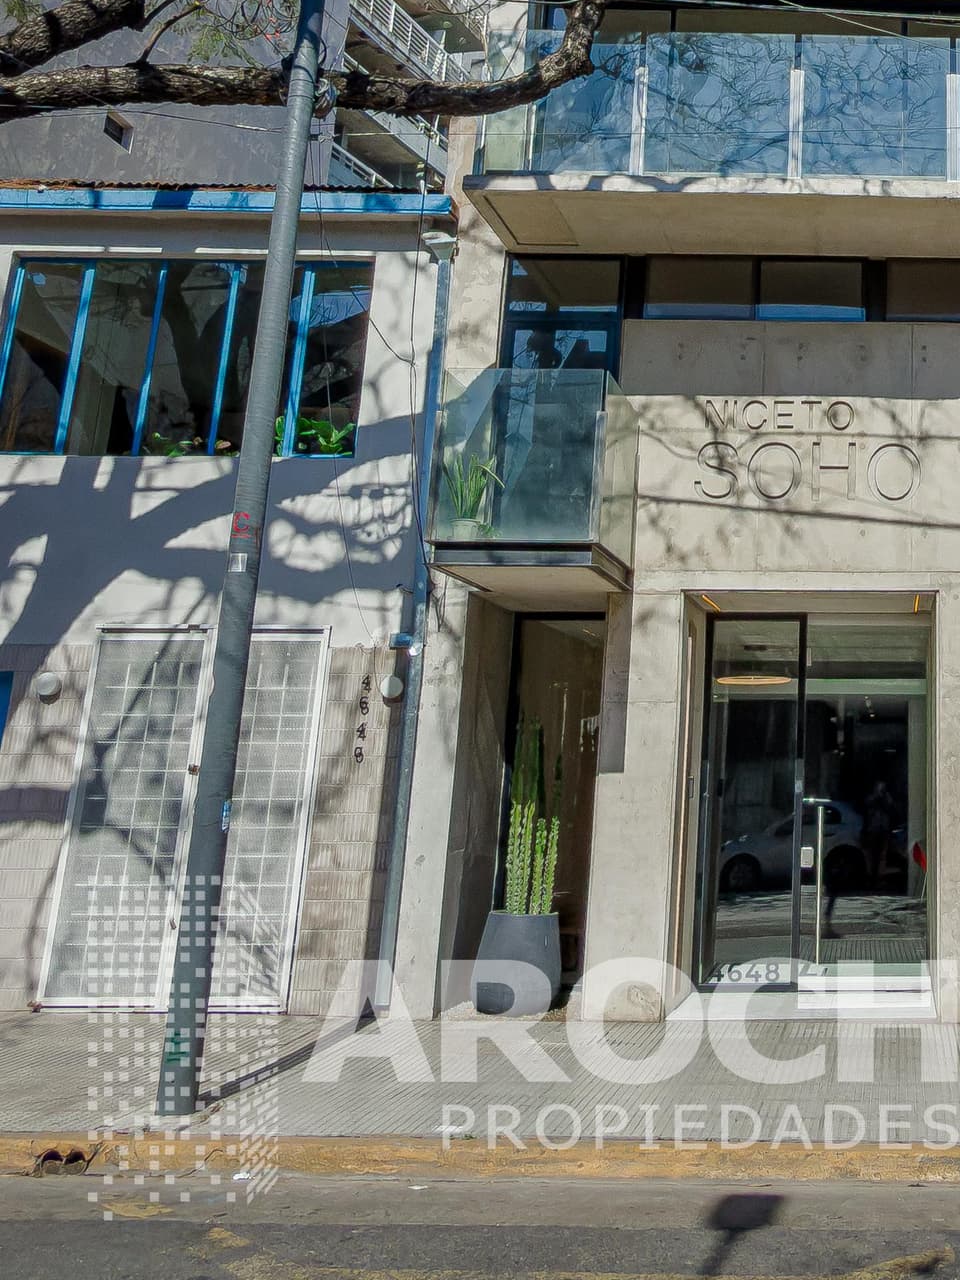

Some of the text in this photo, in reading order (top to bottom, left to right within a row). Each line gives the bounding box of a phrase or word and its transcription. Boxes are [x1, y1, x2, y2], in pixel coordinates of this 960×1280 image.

[704, 400, 855, 431] NICETO
[694, 441, 922, 501] SOHO
[711, 962, 780, 983] 4648
